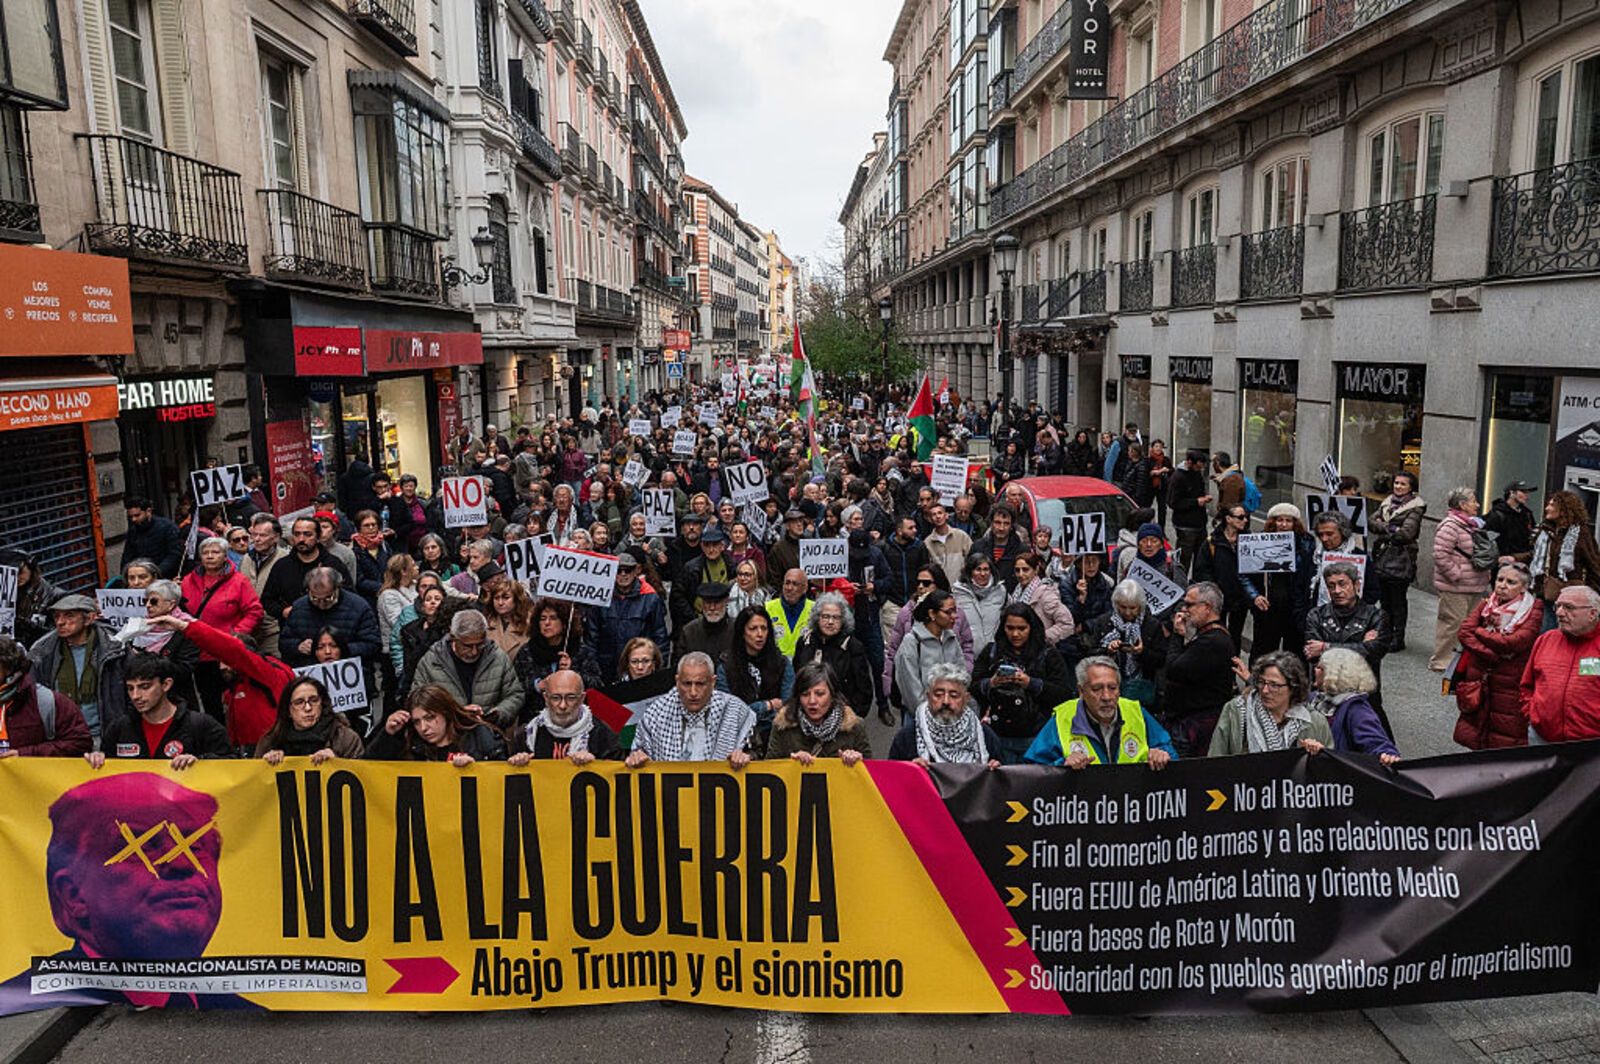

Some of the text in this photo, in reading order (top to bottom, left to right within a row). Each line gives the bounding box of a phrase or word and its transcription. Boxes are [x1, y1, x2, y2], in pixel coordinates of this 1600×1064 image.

[1075, 68, 1103, 76] HOTEL
[26, 310, 60, 321] PRECIOS
[164, 322, 179, 344] 45
[1244, 360, 1288, 385] PLAZA
[1344, 366, 1409, 395] MAYOR
[55, 391, 92, 410] HAND
[116, 378, 215, 411] FAR HOME
[161, 403, 216, 421] HOSTELS
[194, 467, 243, 504] PAZ
[728, 464, 764, 491] NO
[444, 478, 482, 510] NO
[644, 491, 673, 516] PAZ
[1062, 514, 1104, 553] PAZ
[506, 533, 554, 580] PA
[822, 544, 830, 555] A
[832, 544, 845, 555] LA
[544, 554, 611, 577] ¡NO A LA
[804, 563, 847, 576] GUERRA!
[102, 596, 124, 610] ¡NO
[125, 596, 136, 608] A
[543, 579, 611, 602] GUERRA!
[321, 661, 360, 691] NO
[1032, 788, 1187, 827] Salida de la OTAN
[1234, 778, 1354, 813] No al Rearme
[276, 770, 840, 943] NO A LA GUERRA
[1032, 818, 1541, 869] Fin al comercio de armas y a las relaciones con Israel
[1031, 866, 1461, 911] Fuera EEUU de América Latina y Oriente Medio
[1031, 911, 1296, 953] Fuera bases de Rota y Morón
[38, 959, 362, 974] ASAMBLEA INTERNACIONALISTA DE MADRID
[470, 946, 904, 1002] Abajo Trump y el sionismo
[1030, 941, 1572, 995] Solidaridad con los pueblos agredidos por el imperialismo
[37, 976, 363, 991] CONTRA LA GUERRA Y EL IMPERIALISMO
